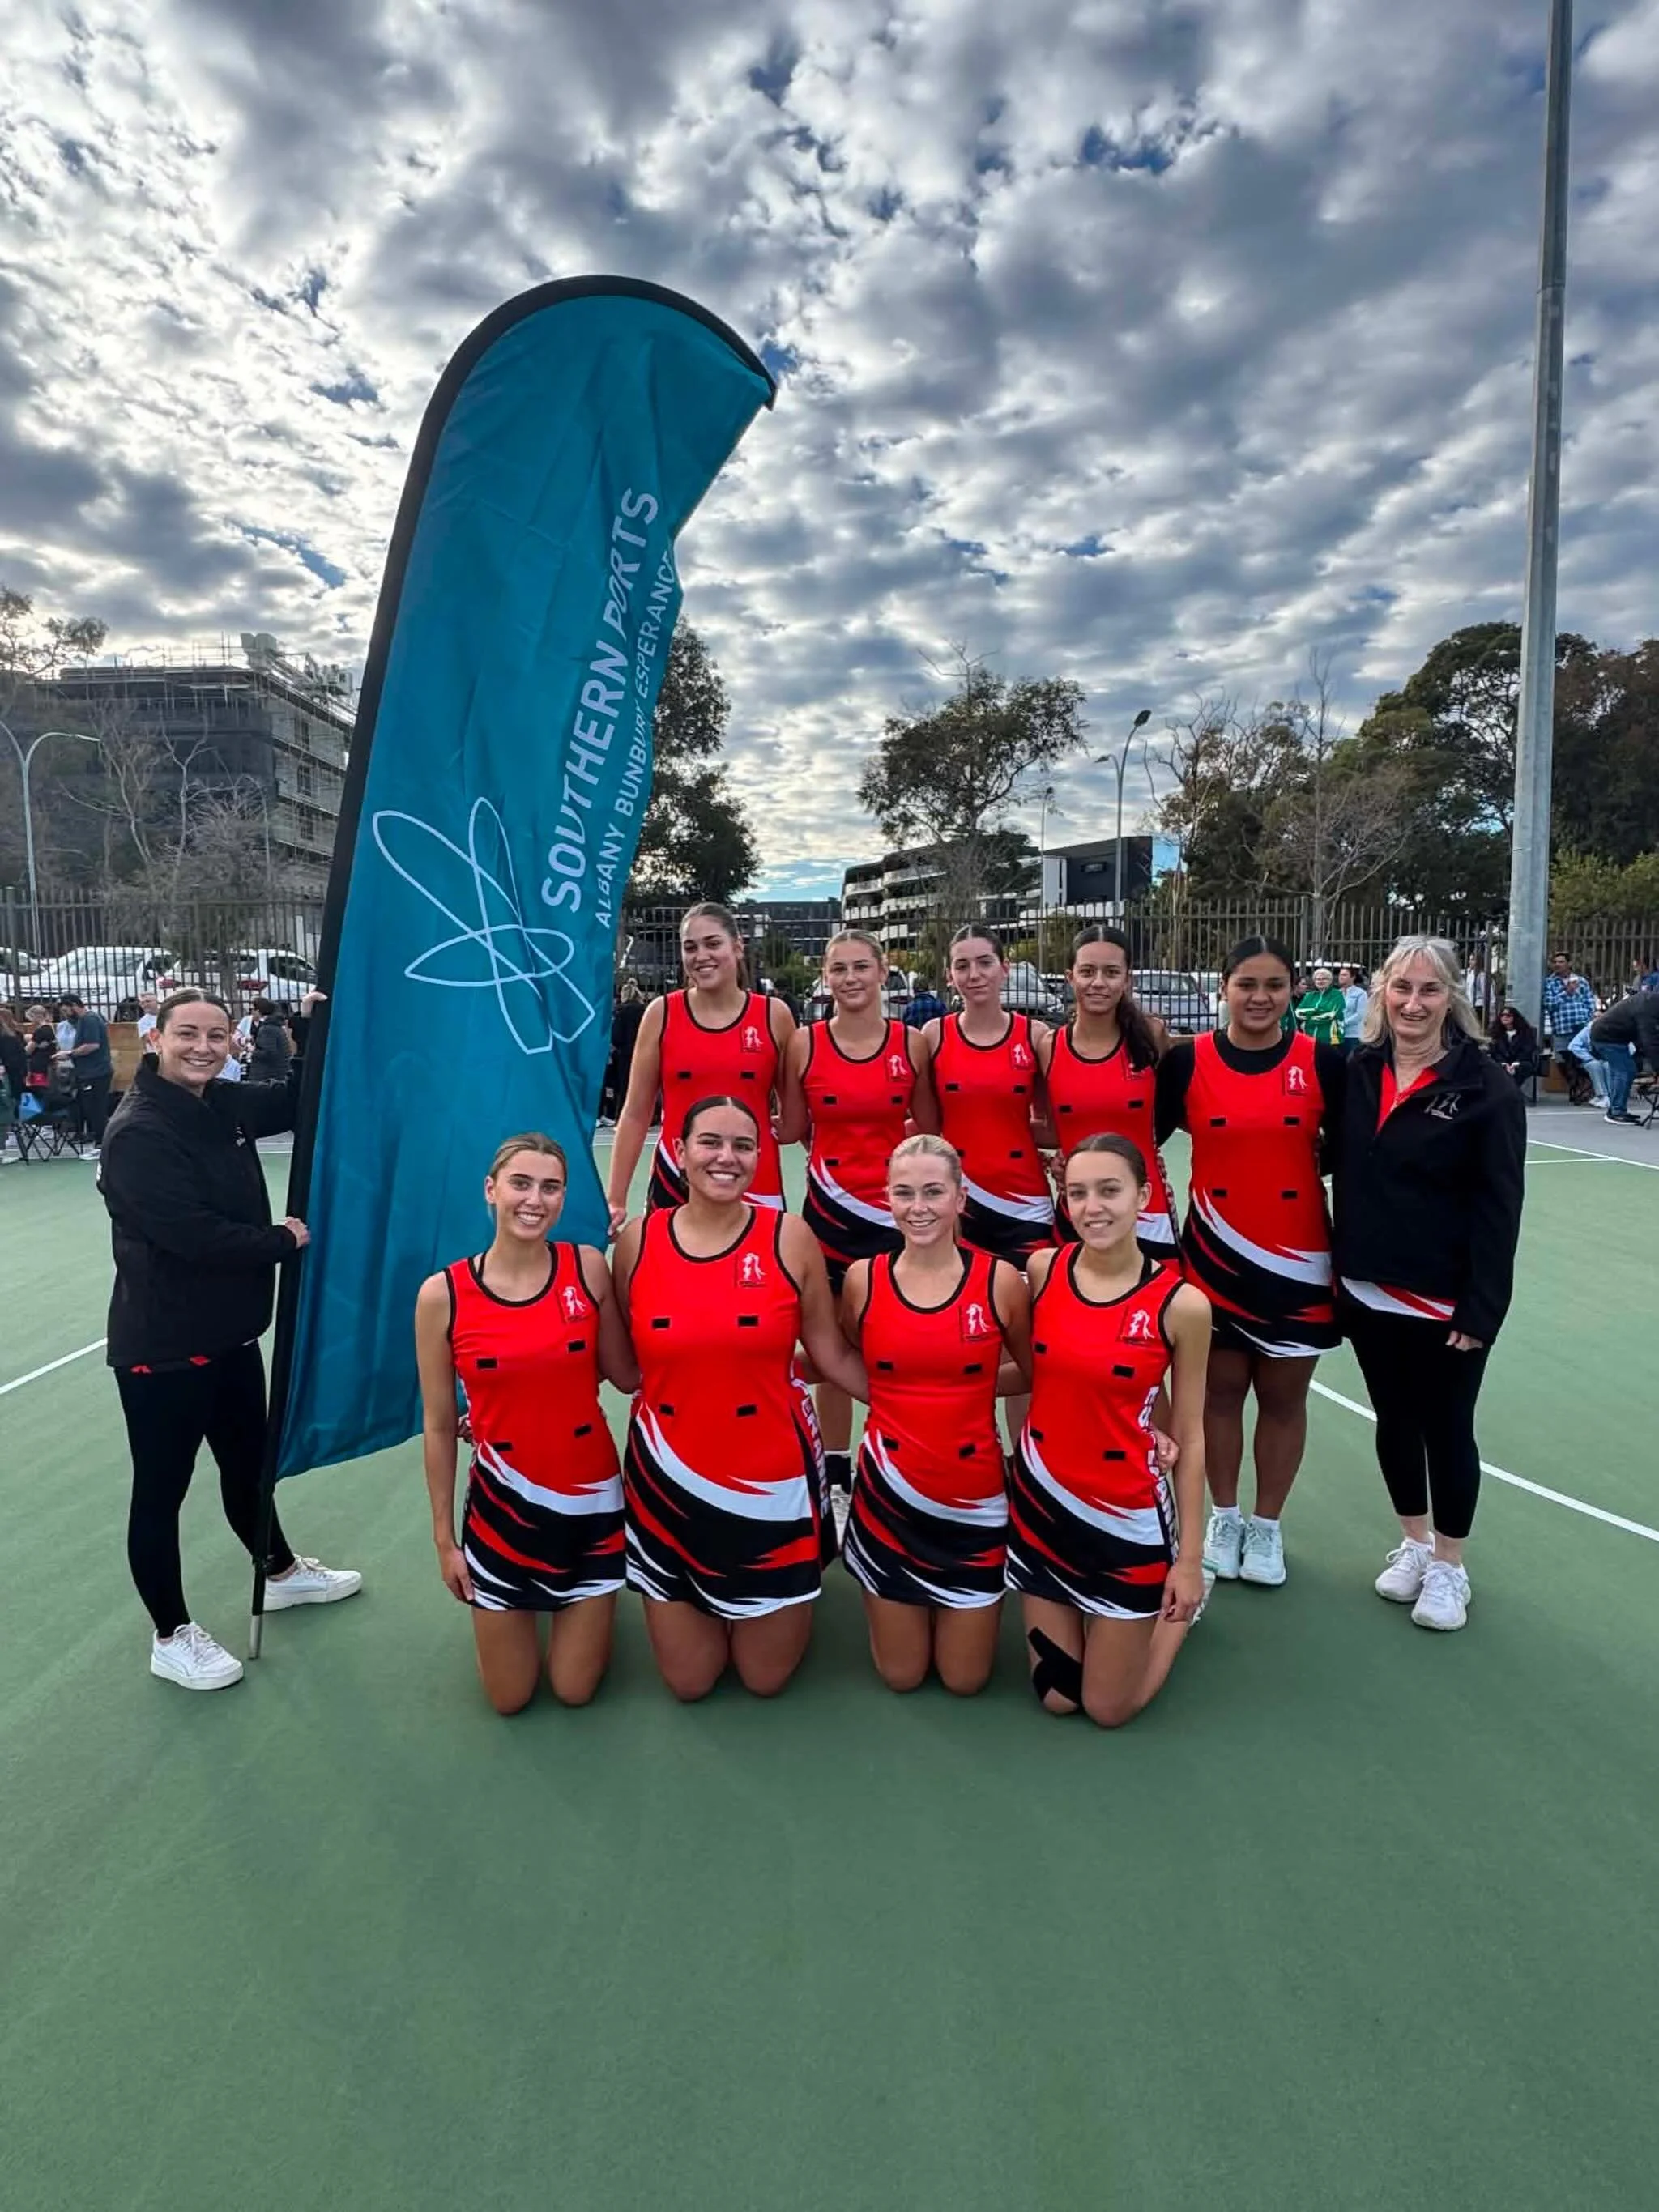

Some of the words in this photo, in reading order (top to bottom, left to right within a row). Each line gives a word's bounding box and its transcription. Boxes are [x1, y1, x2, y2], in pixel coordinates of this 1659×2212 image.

[541, 639, 629, 914] SOUTHERN
[603, 488, 659, 641] PORTS
[595, 823, 626, 929] ALBANY
[614, 698, 647, 817] BUNBURY
